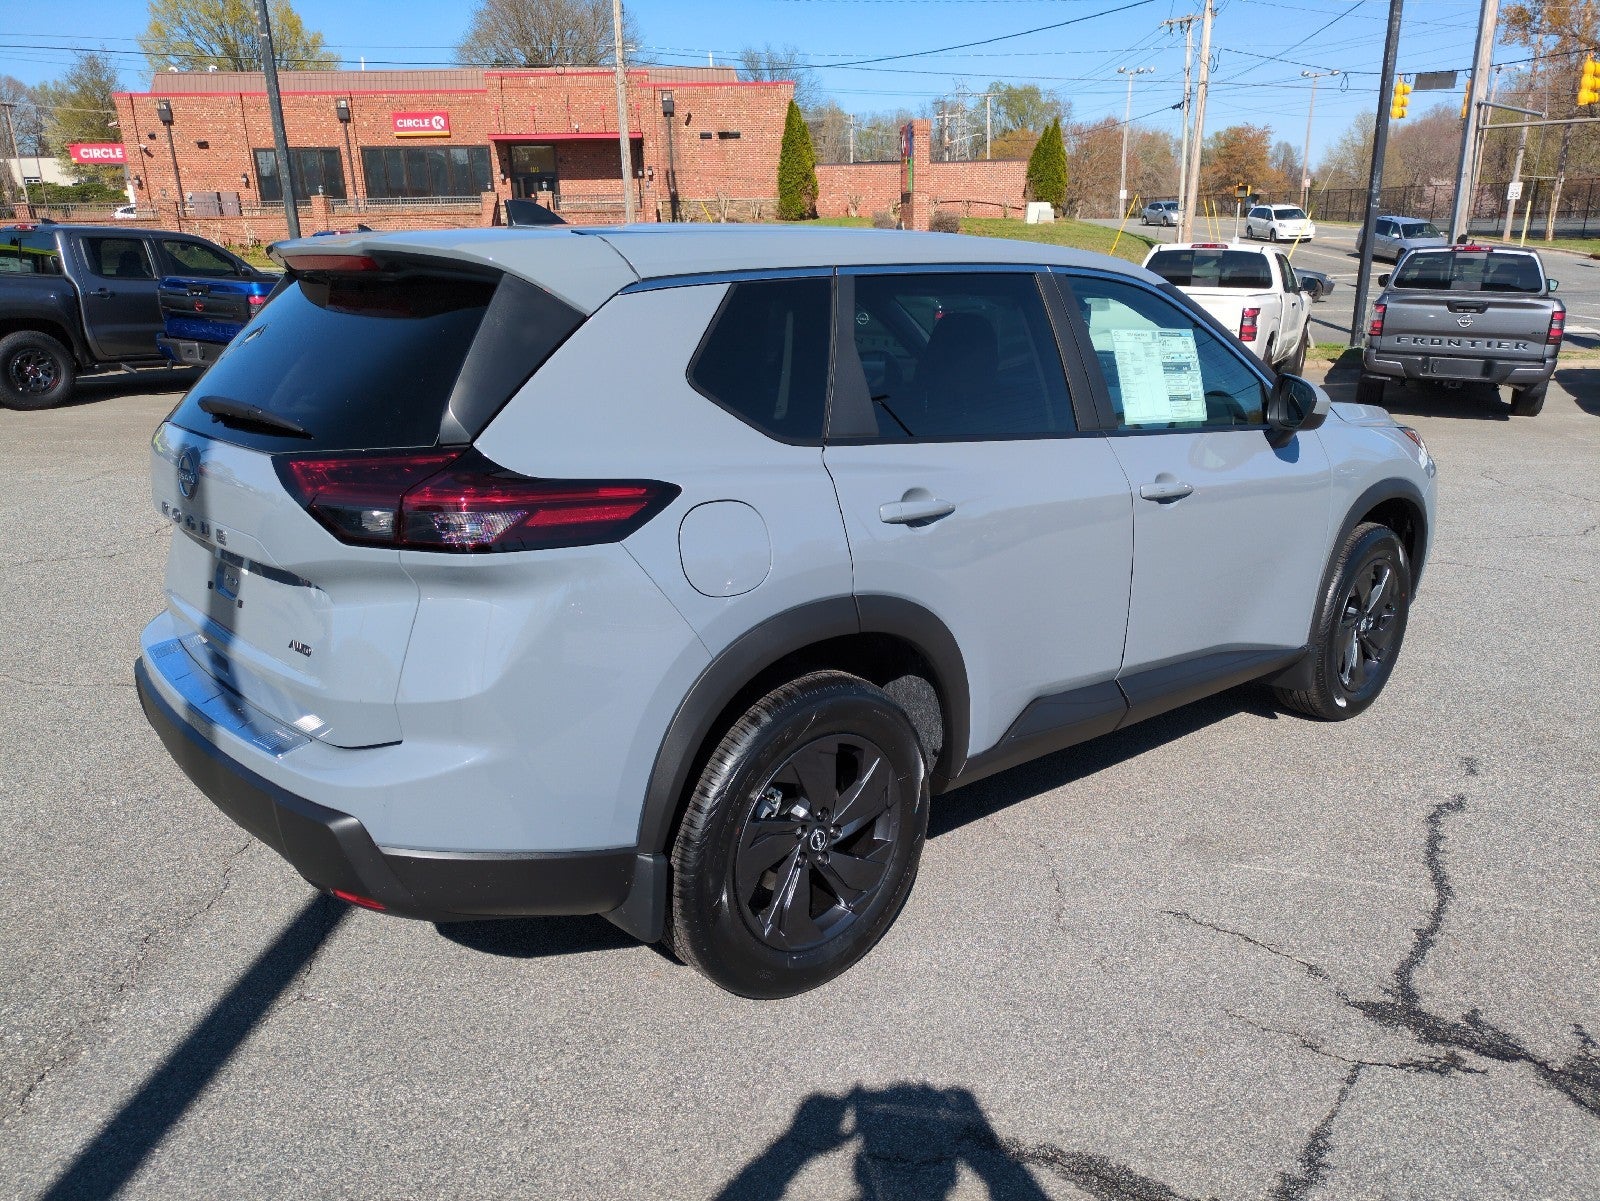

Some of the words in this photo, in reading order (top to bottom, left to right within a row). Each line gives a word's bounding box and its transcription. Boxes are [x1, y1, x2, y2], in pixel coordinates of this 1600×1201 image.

[397, 118, 430, 128] CIRCLE
[432, 116, 445, 130] K
[80, 148, 123, 159] CIRCLE
[1395, 336, 1529, 351] FRONTIER
[161, 501, 228, 545] ROGUE
